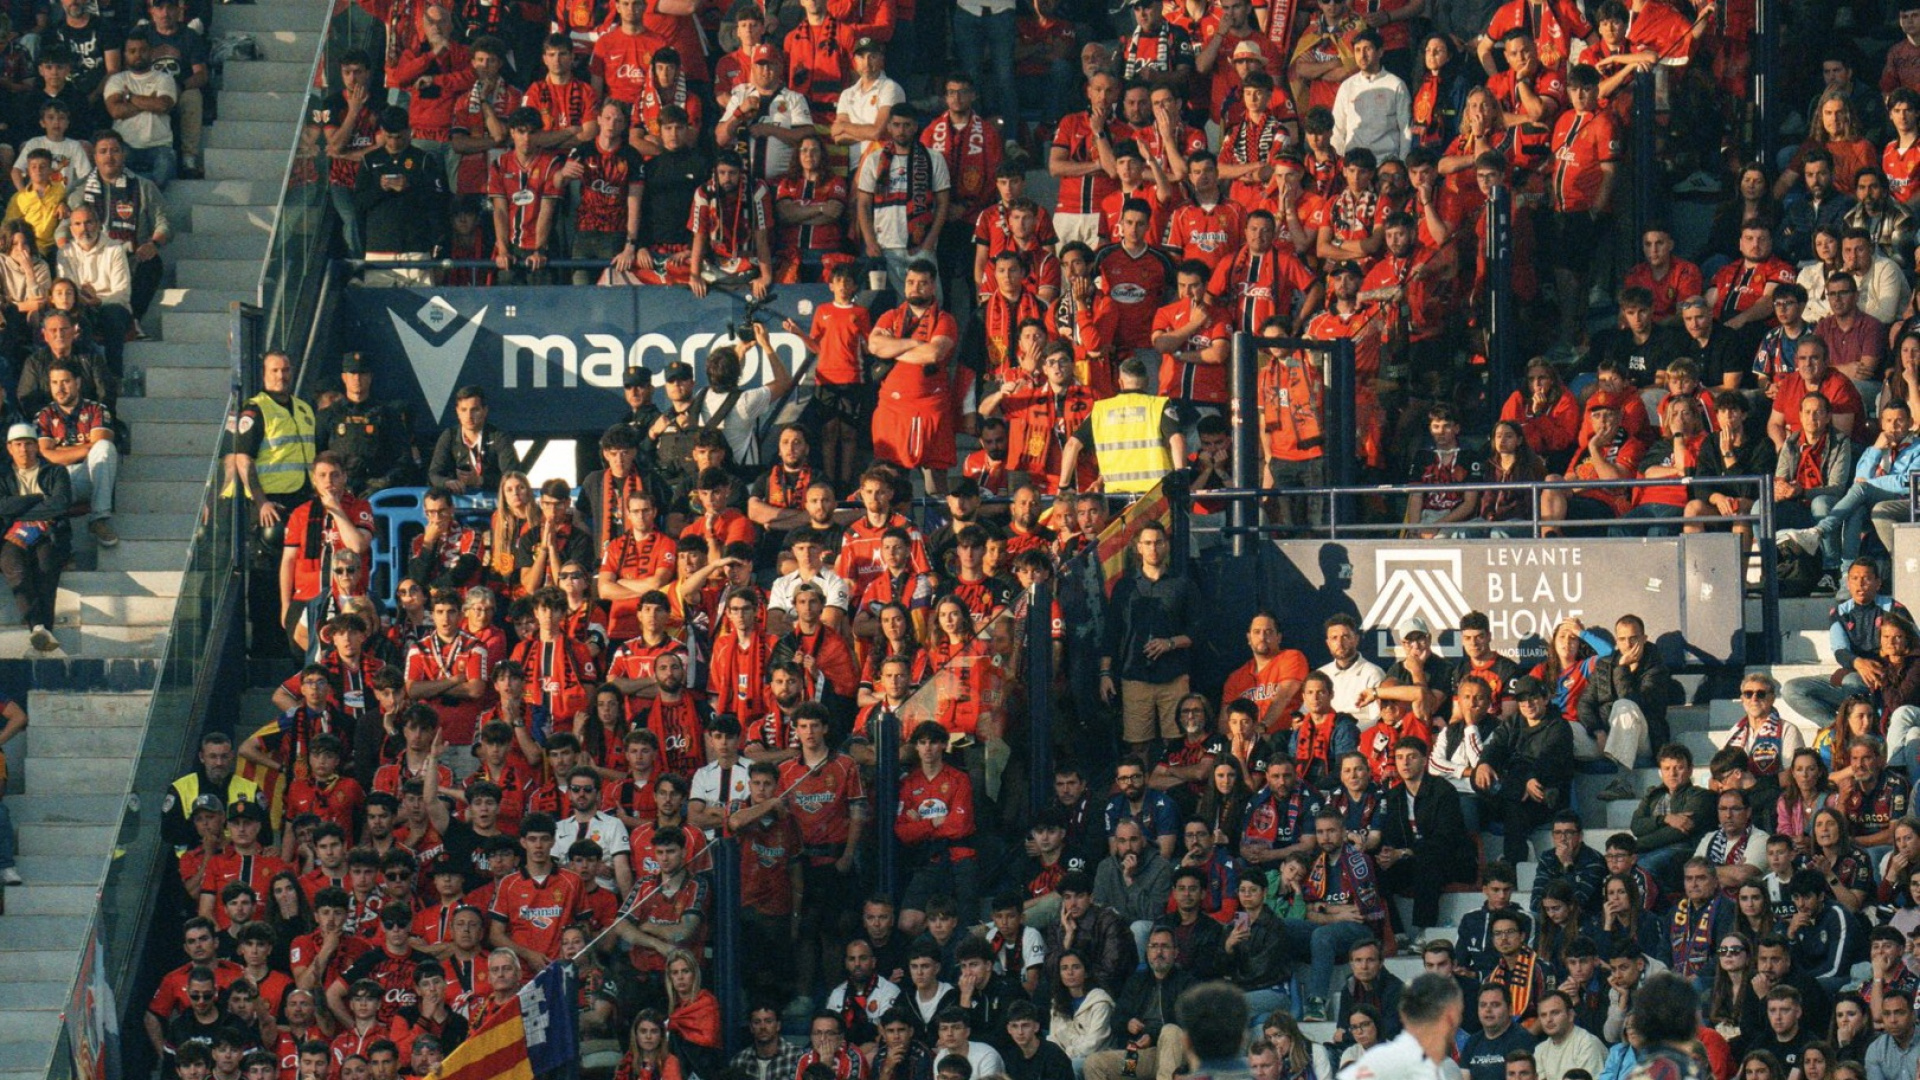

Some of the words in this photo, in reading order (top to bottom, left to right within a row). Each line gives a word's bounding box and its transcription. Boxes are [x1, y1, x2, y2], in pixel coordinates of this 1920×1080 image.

[932, 121, 947, 152] RCD
[503, 333, 807, 388] macron
[1487, 548, 1581, 566] LEVANTE
[1488, 571, 1582, 603] BLAU
[1488, 609, 1584, 641] HOM
[1497, 648, 1548, 658] MOBILIARIA
